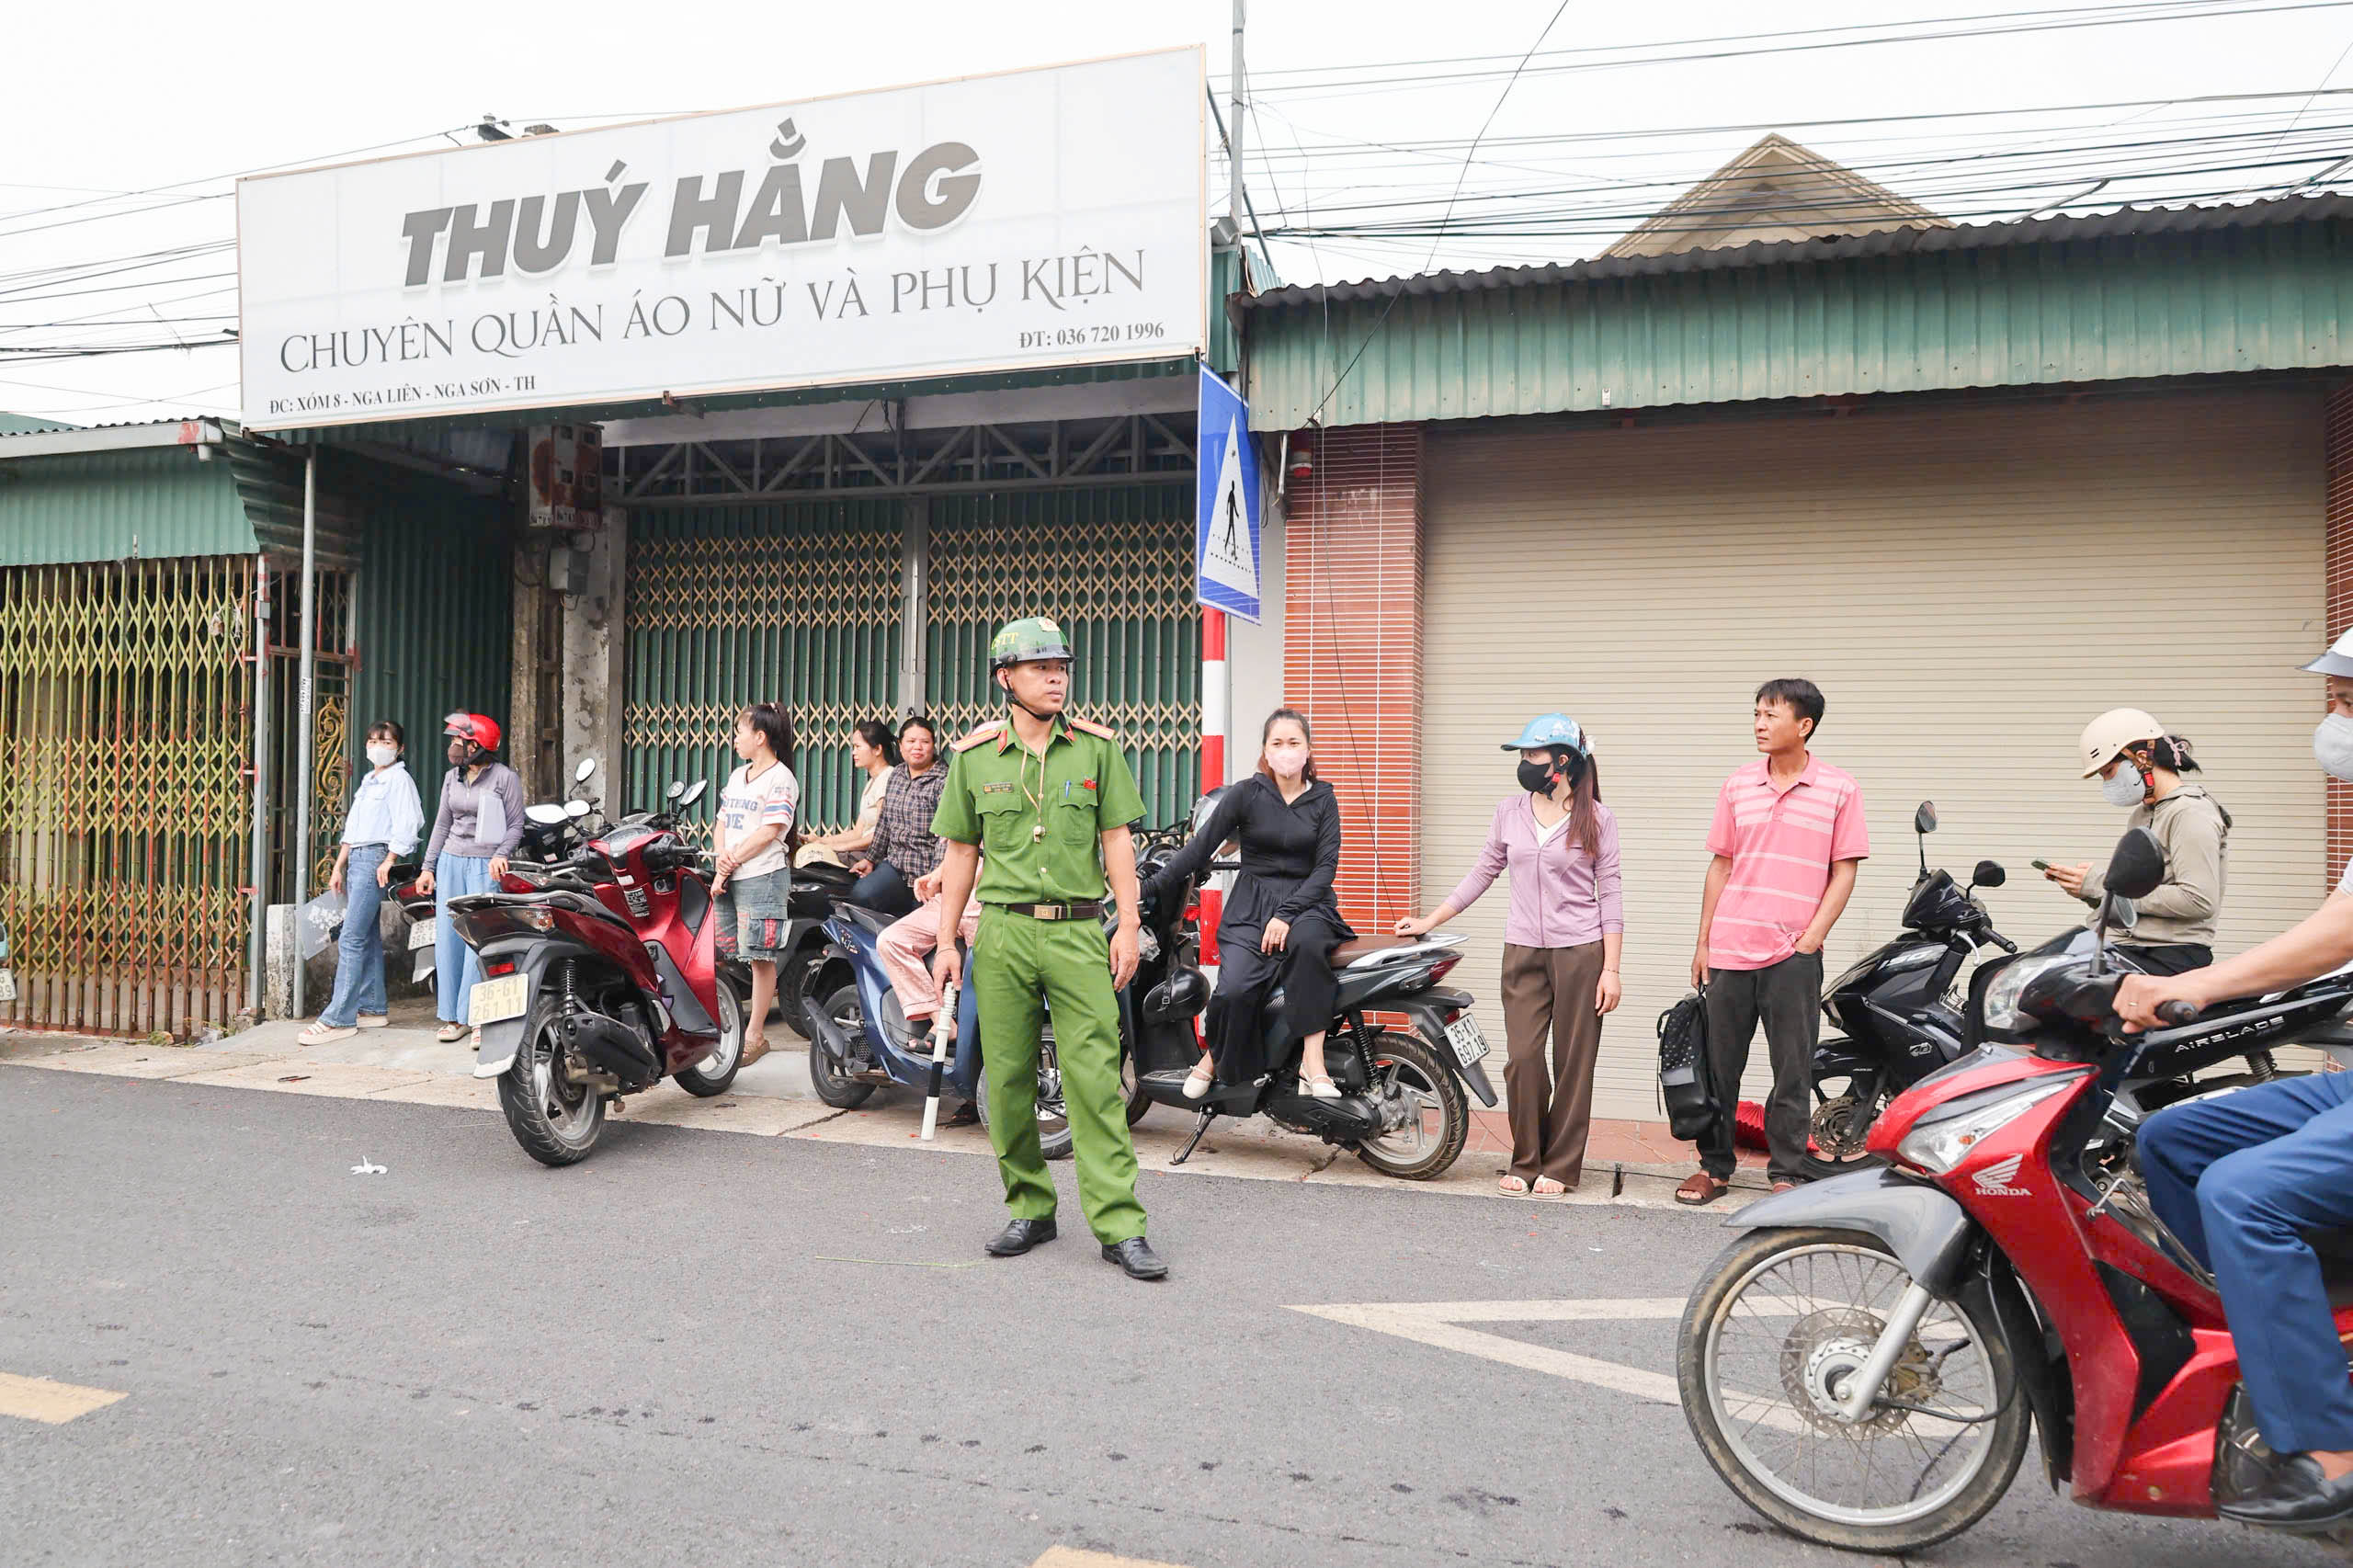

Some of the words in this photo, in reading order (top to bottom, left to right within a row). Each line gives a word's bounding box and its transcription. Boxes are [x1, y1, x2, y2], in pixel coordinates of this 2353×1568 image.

[403, 160, 649, 286] THUÝ
[664, 117, 982, 257] HẰNG
[281, 316, 452, 372] CHUYÊN
[472, 293, 601, 358] QUẦN
[624, 290, 689, 338] ÁO
[710, 278, 786, 330] NỮ
[807, 267, 869, 320] VÀ
[892, 264, 996, 312] PHỤ
[1022, 245, 1143, 310] KIỆN
[1020, 331, 1051, 348] ĐT:
[1057, 329, 1086, 345] 036
[1091, 326, 1120, 342] 720
[1128, 323, 1164, 340] 1996
[269, 399, 293, 415] ĐC:
[297, 392, 330, 412] XÓM
[333, 394, 341, 408] 8
[352, 391, 383, 405] NGA
[387, 382, 421, 403] LIÊN
[434, 382, 466, 398] NGA
[470, 377, 501, 396] SƠN
[515, 375, 536, 392] TH
[1458, 1035, 1487, 1064] 697.19
[1975, 1187, 2033, 1196] HONDA
